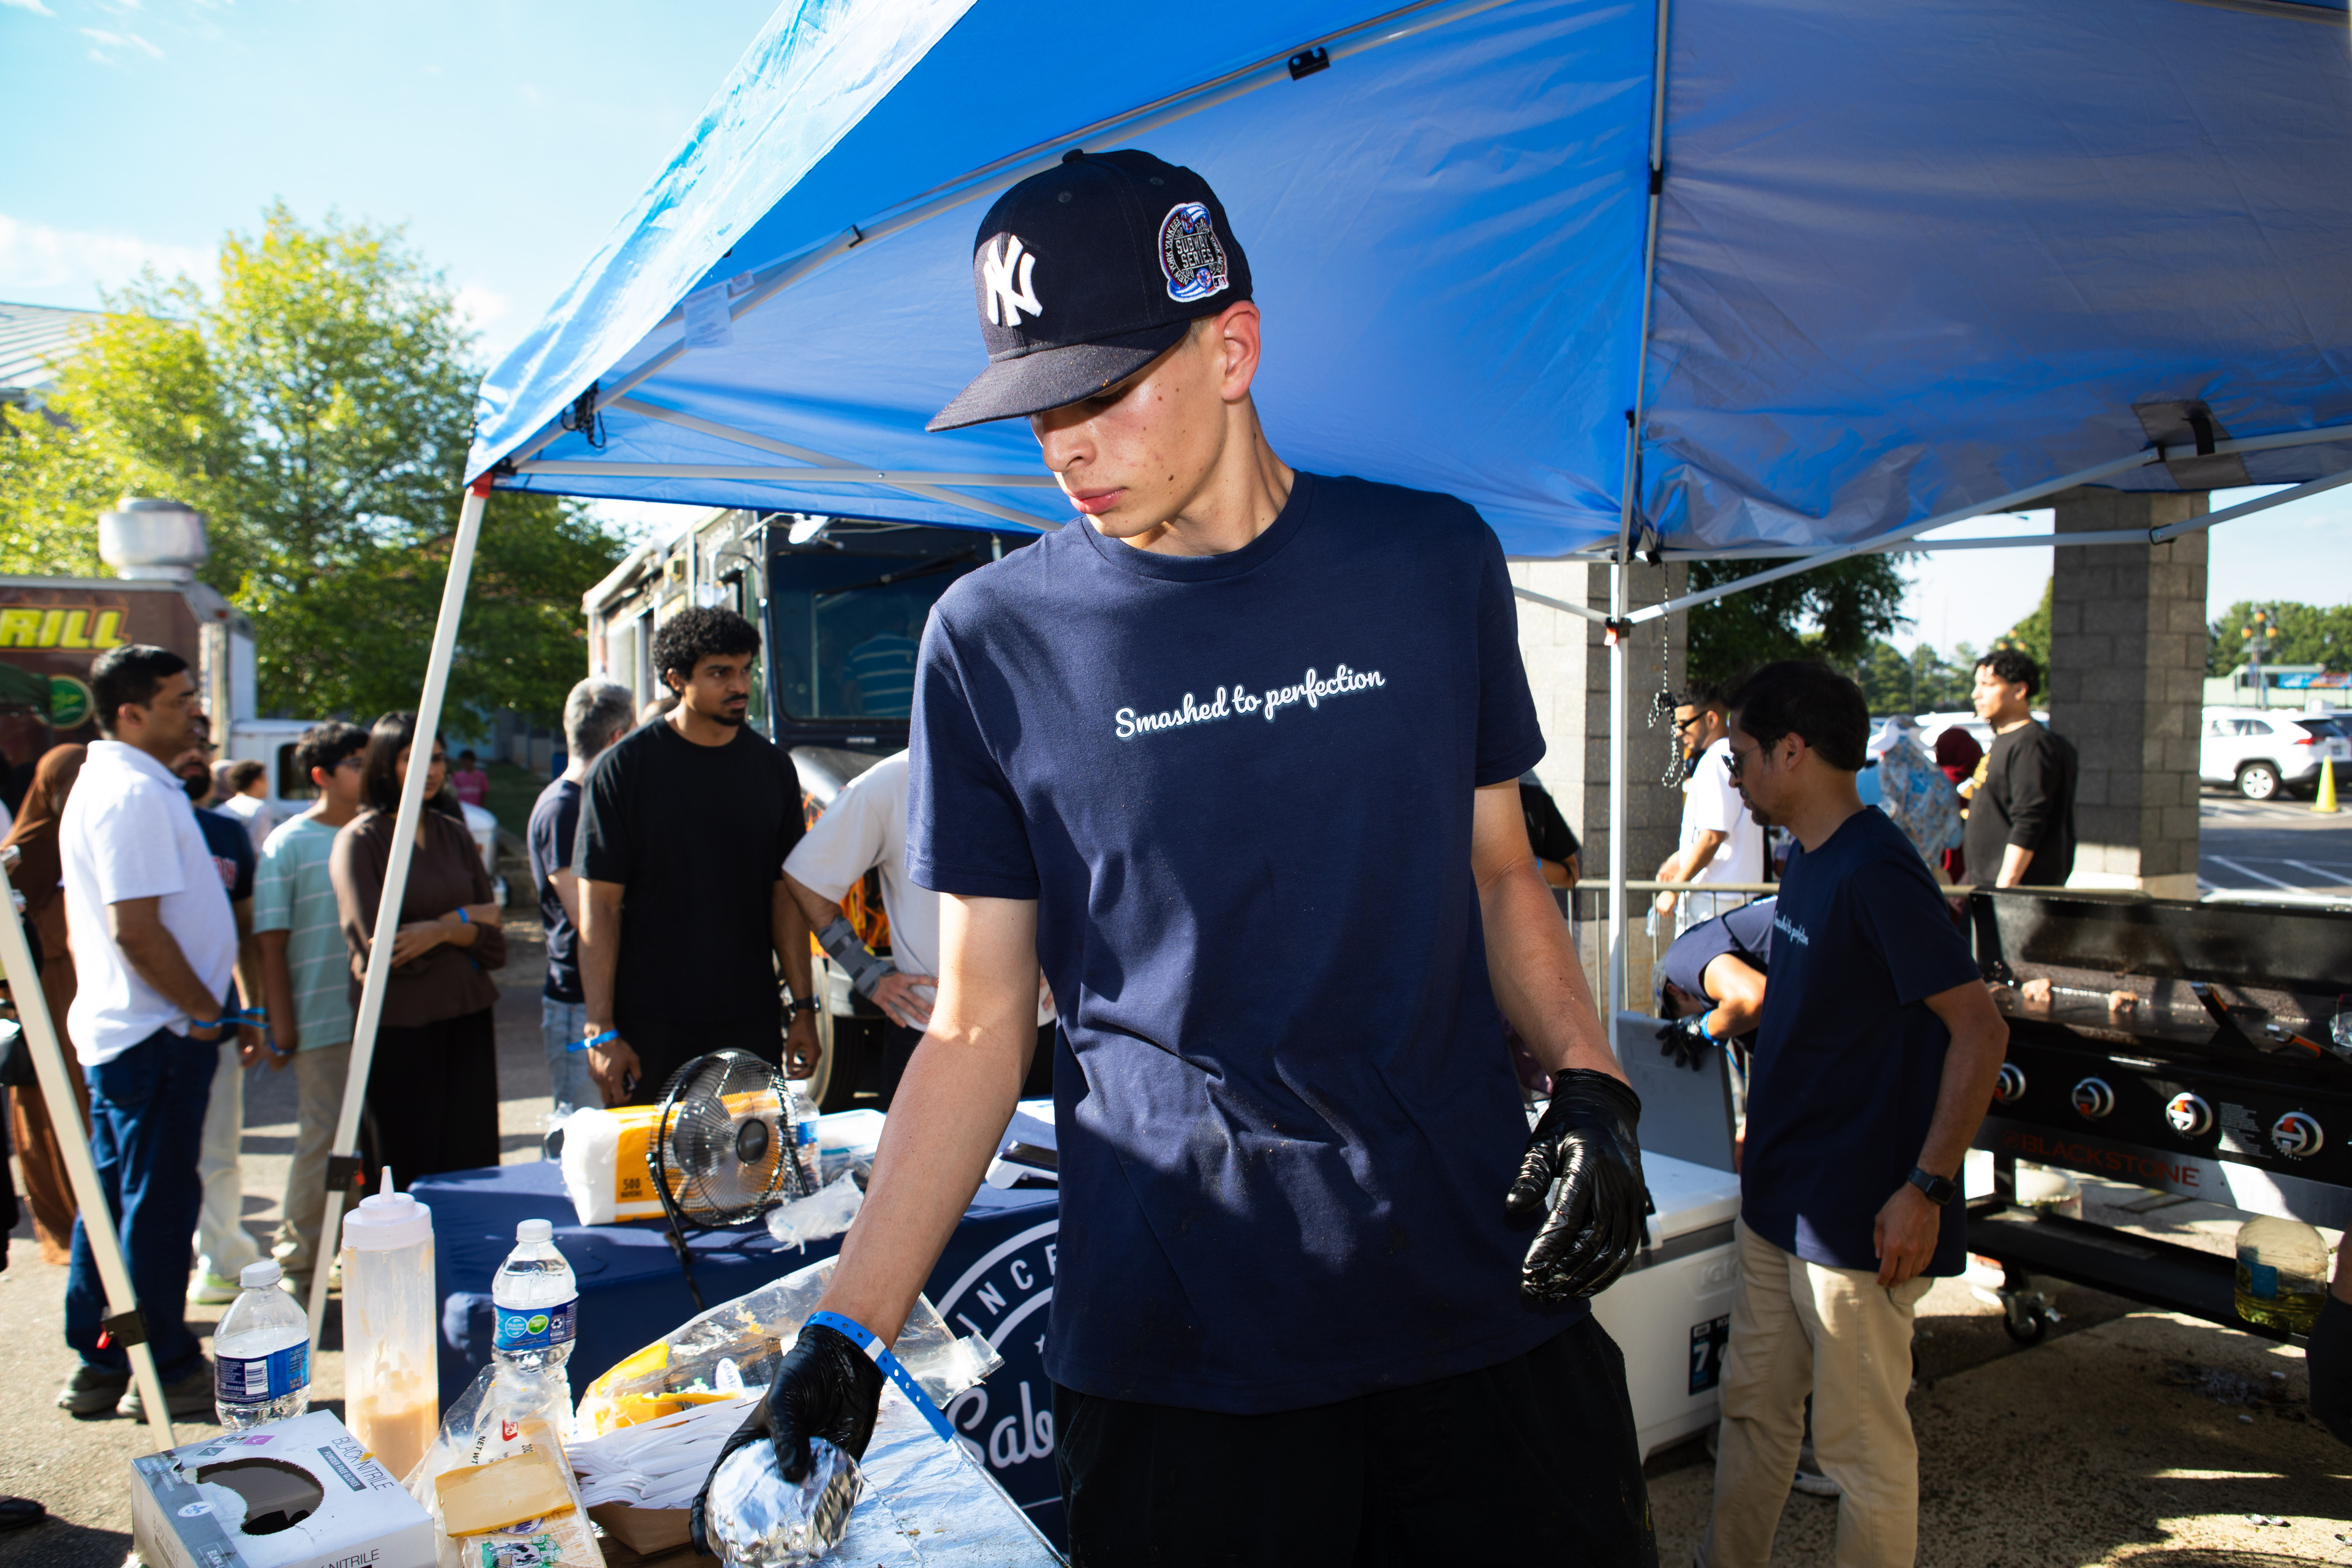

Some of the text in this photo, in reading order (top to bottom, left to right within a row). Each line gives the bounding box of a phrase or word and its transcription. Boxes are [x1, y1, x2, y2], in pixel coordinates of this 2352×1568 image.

[1165, 216, 1189, 285] NEW YORK YANKEES
[1175, 235, 1209, 255] SUBWAY
[1181, 248, 1214, 268] SERIES
[983, 235, 1042, 327] NY
[1115, 664, 1386, 739] Smashed to perfection
[623, 1177, 641, 1190] 500
[2022, 1134, 2200, 1188] BLACKSTONE
[323, 1450, 360, 1487] POWDER FREE GLOVES
[331, 1436, 394, 1491] BLACK NITRILE
[471, 1436, 486, 1464] NET WT
